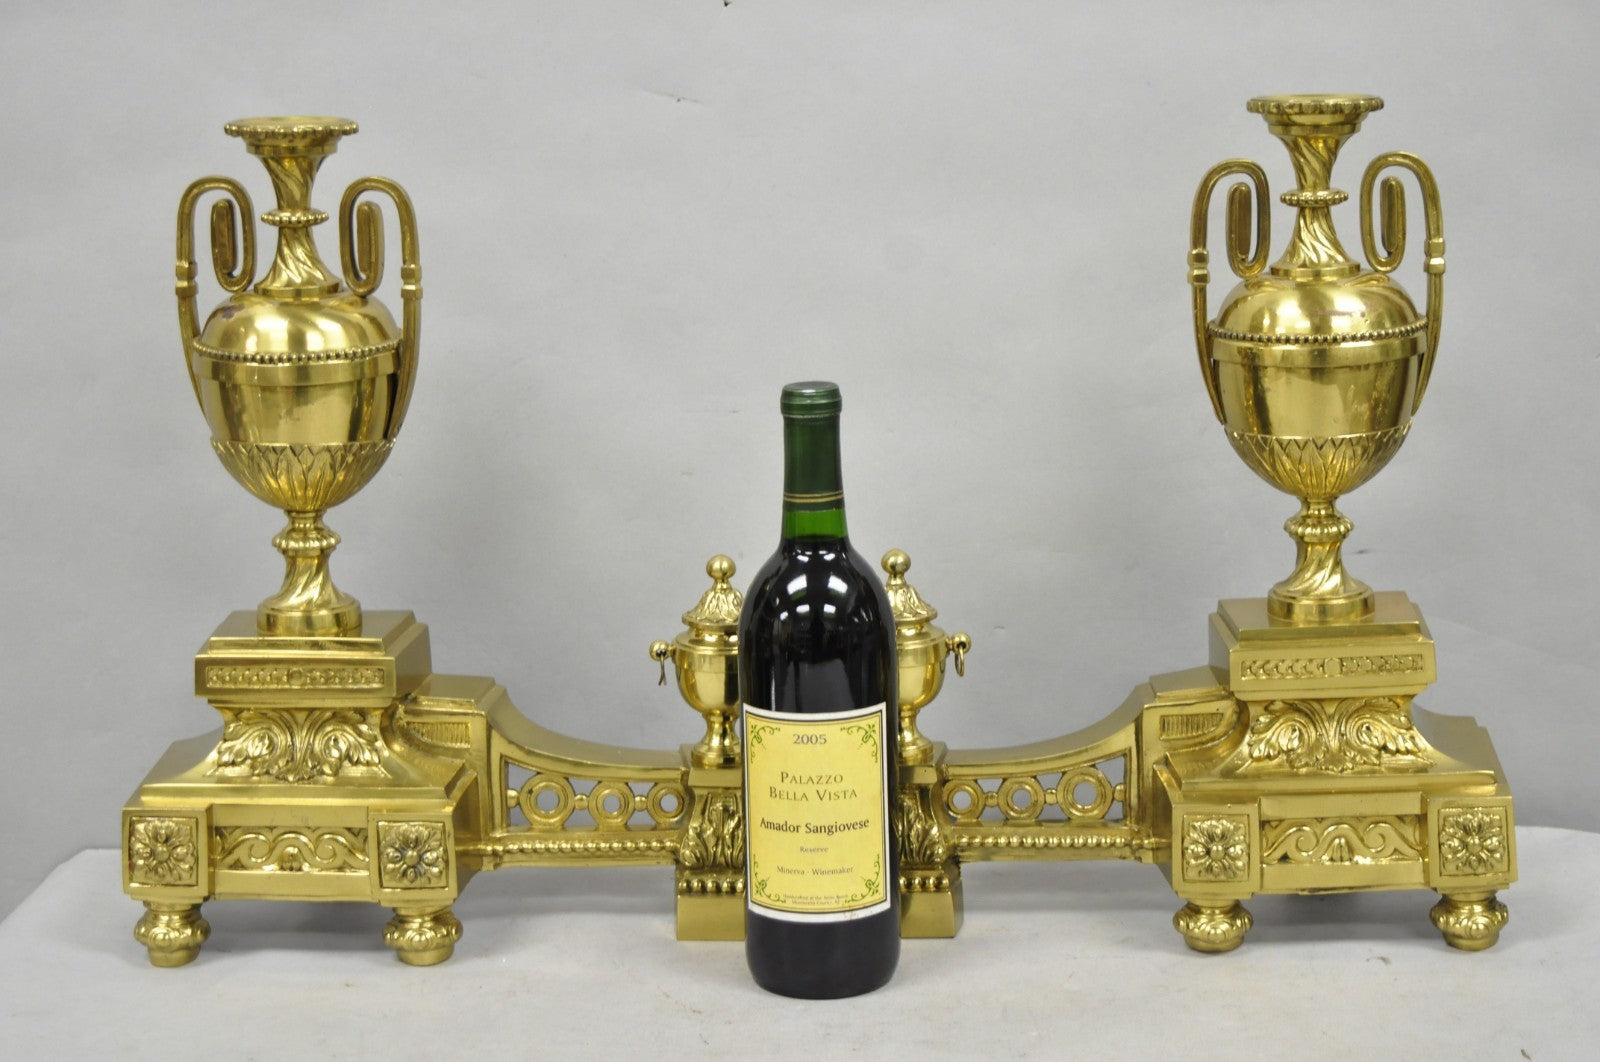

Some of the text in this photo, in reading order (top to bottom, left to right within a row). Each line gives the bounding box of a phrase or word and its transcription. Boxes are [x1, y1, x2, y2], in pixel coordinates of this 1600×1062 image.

[792, 733, 827, 745] 2005
[780, 771, 844, 785] PALAZZO
[769, 786, 858, 801] BELLA VISTA
[760, 817, 869, 836] Amador Sangiovese
[776, 866, 854, 876] Minerva Winemaker
